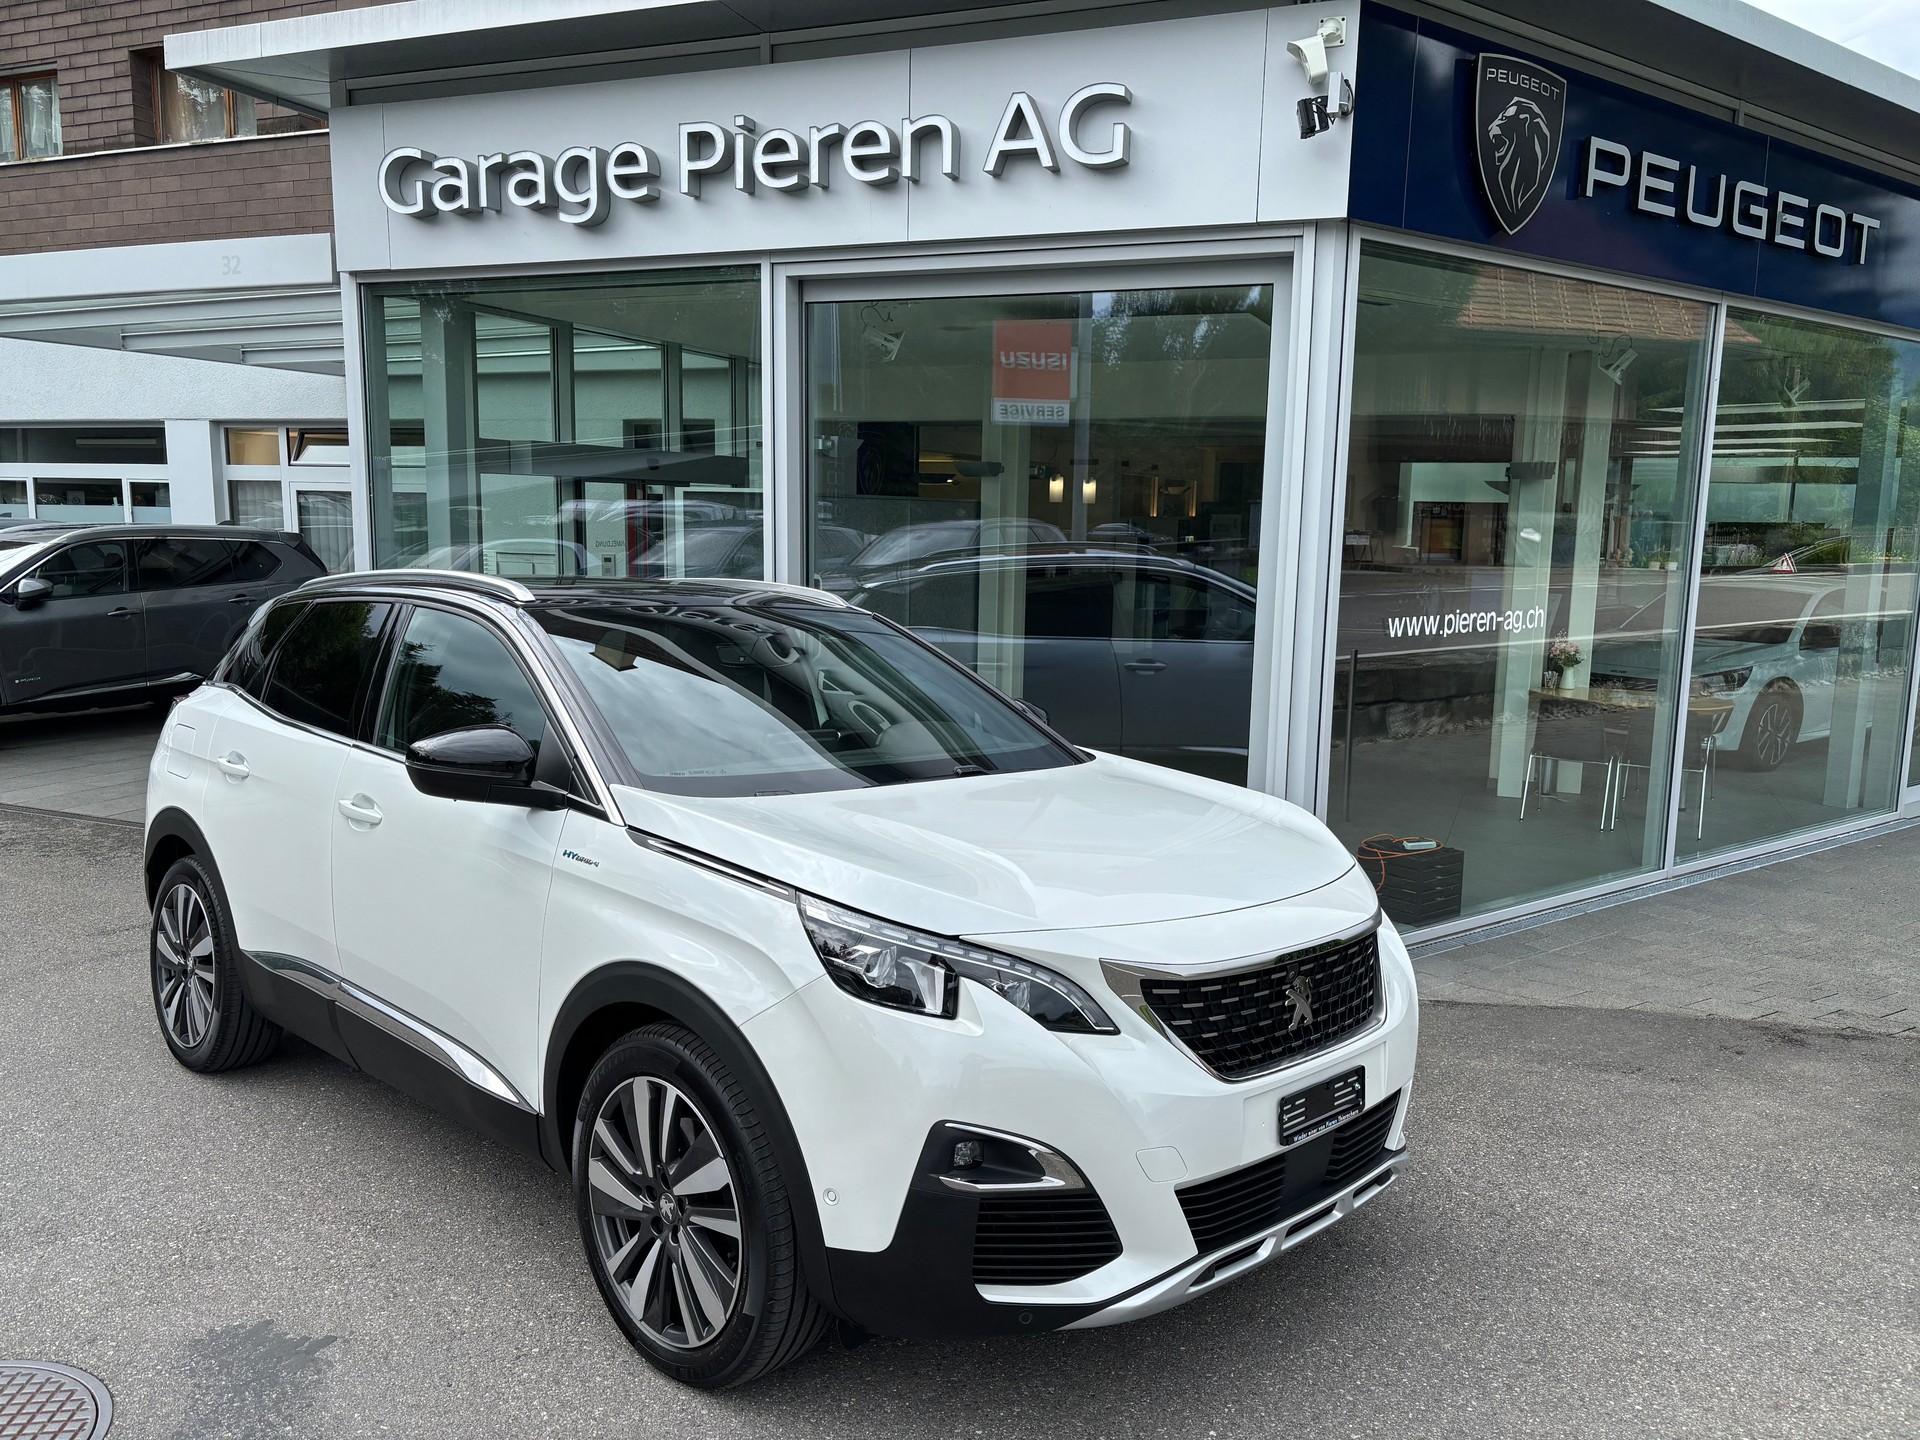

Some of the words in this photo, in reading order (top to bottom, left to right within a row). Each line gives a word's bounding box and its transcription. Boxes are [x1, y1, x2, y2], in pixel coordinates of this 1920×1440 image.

[1486, 67, 1560, 100] PEUGEOT
[378, 141, 659, 226] Garage
[678, 113, 959, 197] Pieren
[983, 82, 1132, 176] AG
[1584, 136, 1880, 265] PEUGEOT
[221, 254, 242, 275] 32
[1387, 605, 1545, 638] www.pieren-ag.ch
